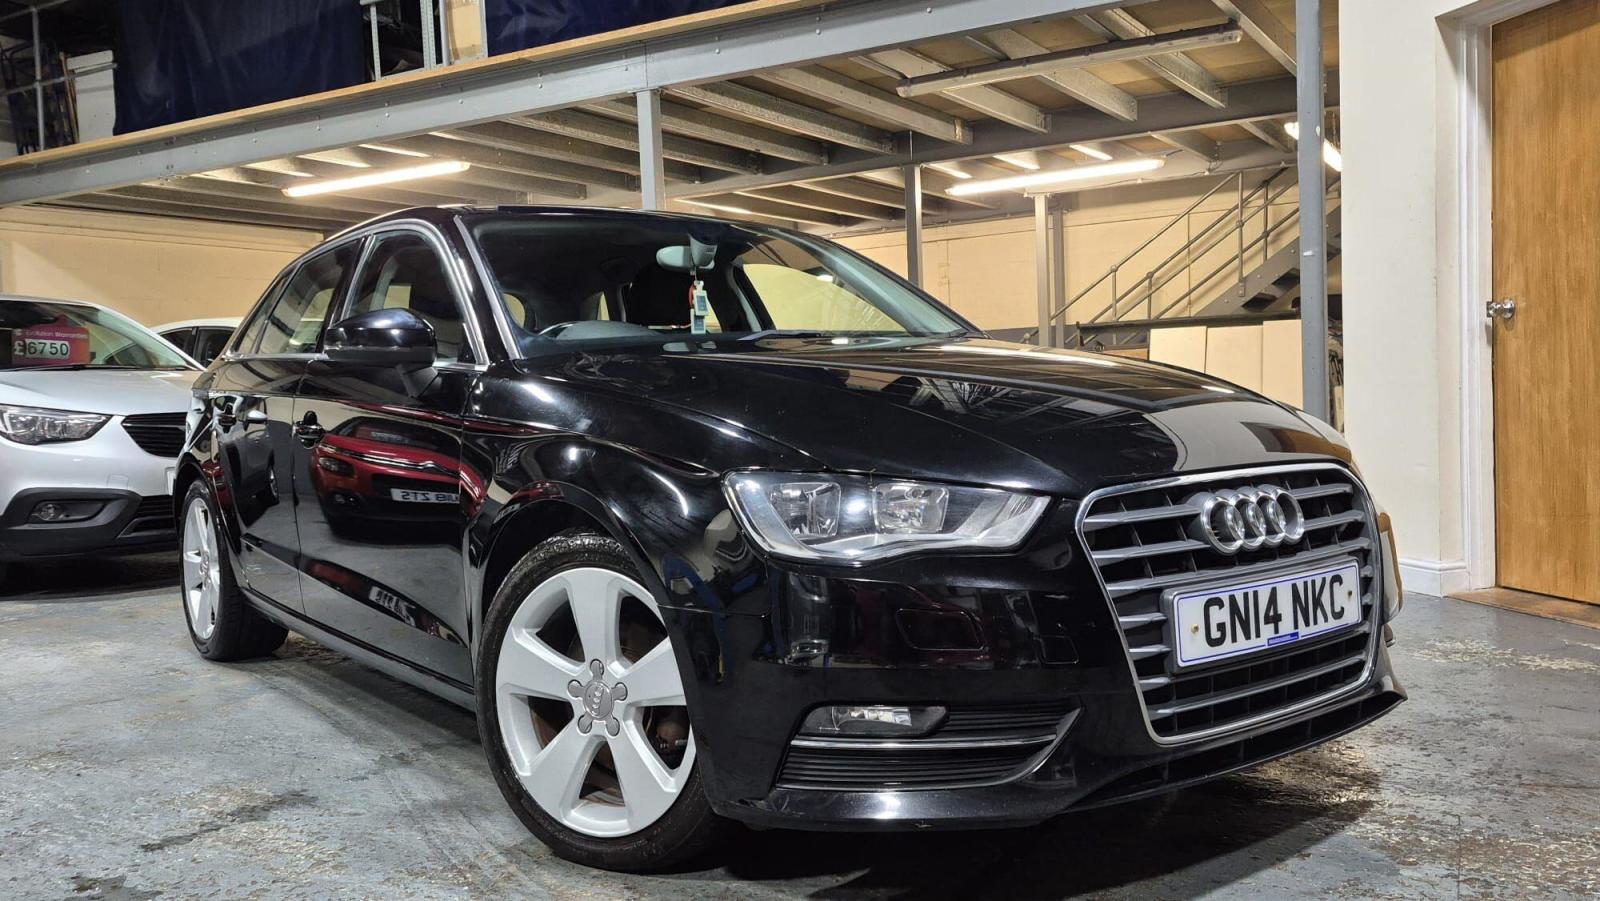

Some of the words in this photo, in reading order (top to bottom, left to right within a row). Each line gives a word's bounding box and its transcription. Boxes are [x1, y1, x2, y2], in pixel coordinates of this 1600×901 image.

[14, 341, 69, 356] £6750
[1203, 586, 1282, 648] GN14
[1291, 574, 1345, 630] NKC
